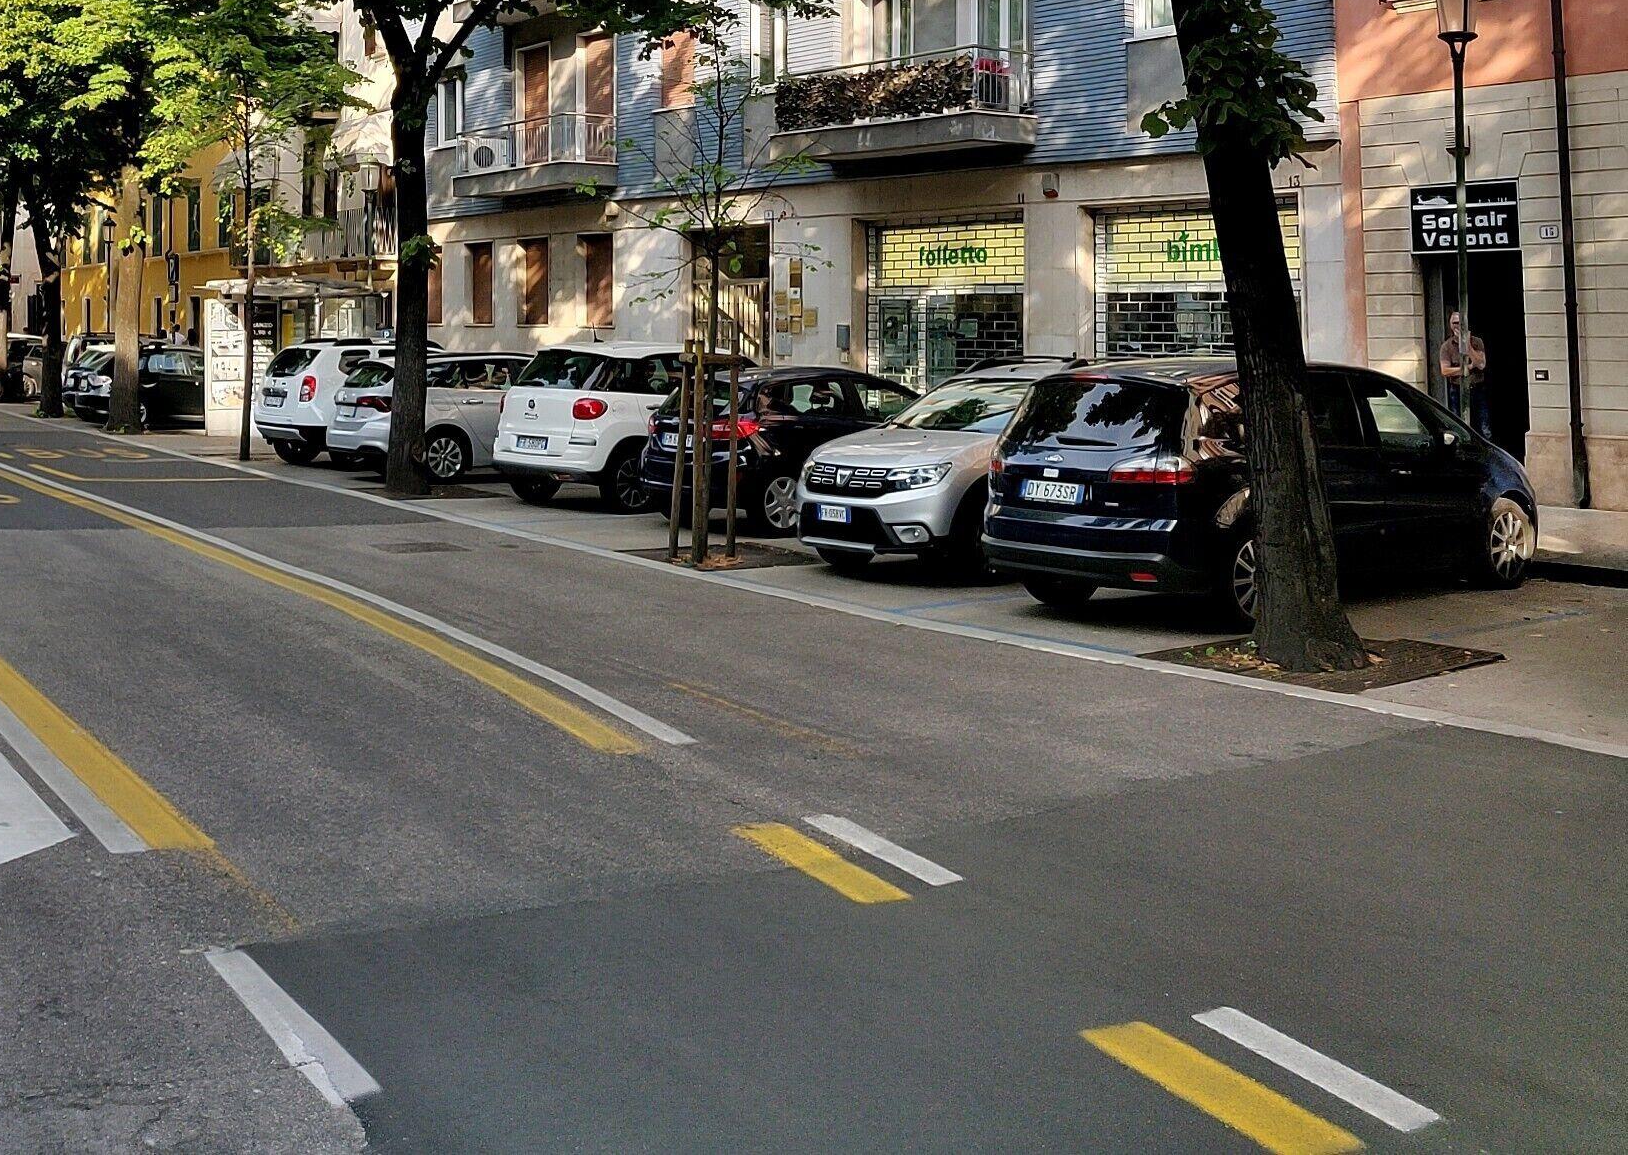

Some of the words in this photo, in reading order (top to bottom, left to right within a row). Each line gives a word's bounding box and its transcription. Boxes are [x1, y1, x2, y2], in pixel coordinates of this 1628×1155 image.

[1288, 175, 1301, 187] 13
[919, 245, 988, 267] folletto
[14, 447, 150, 460] BUS
[1043, 484, 1077, 500] 673SR
